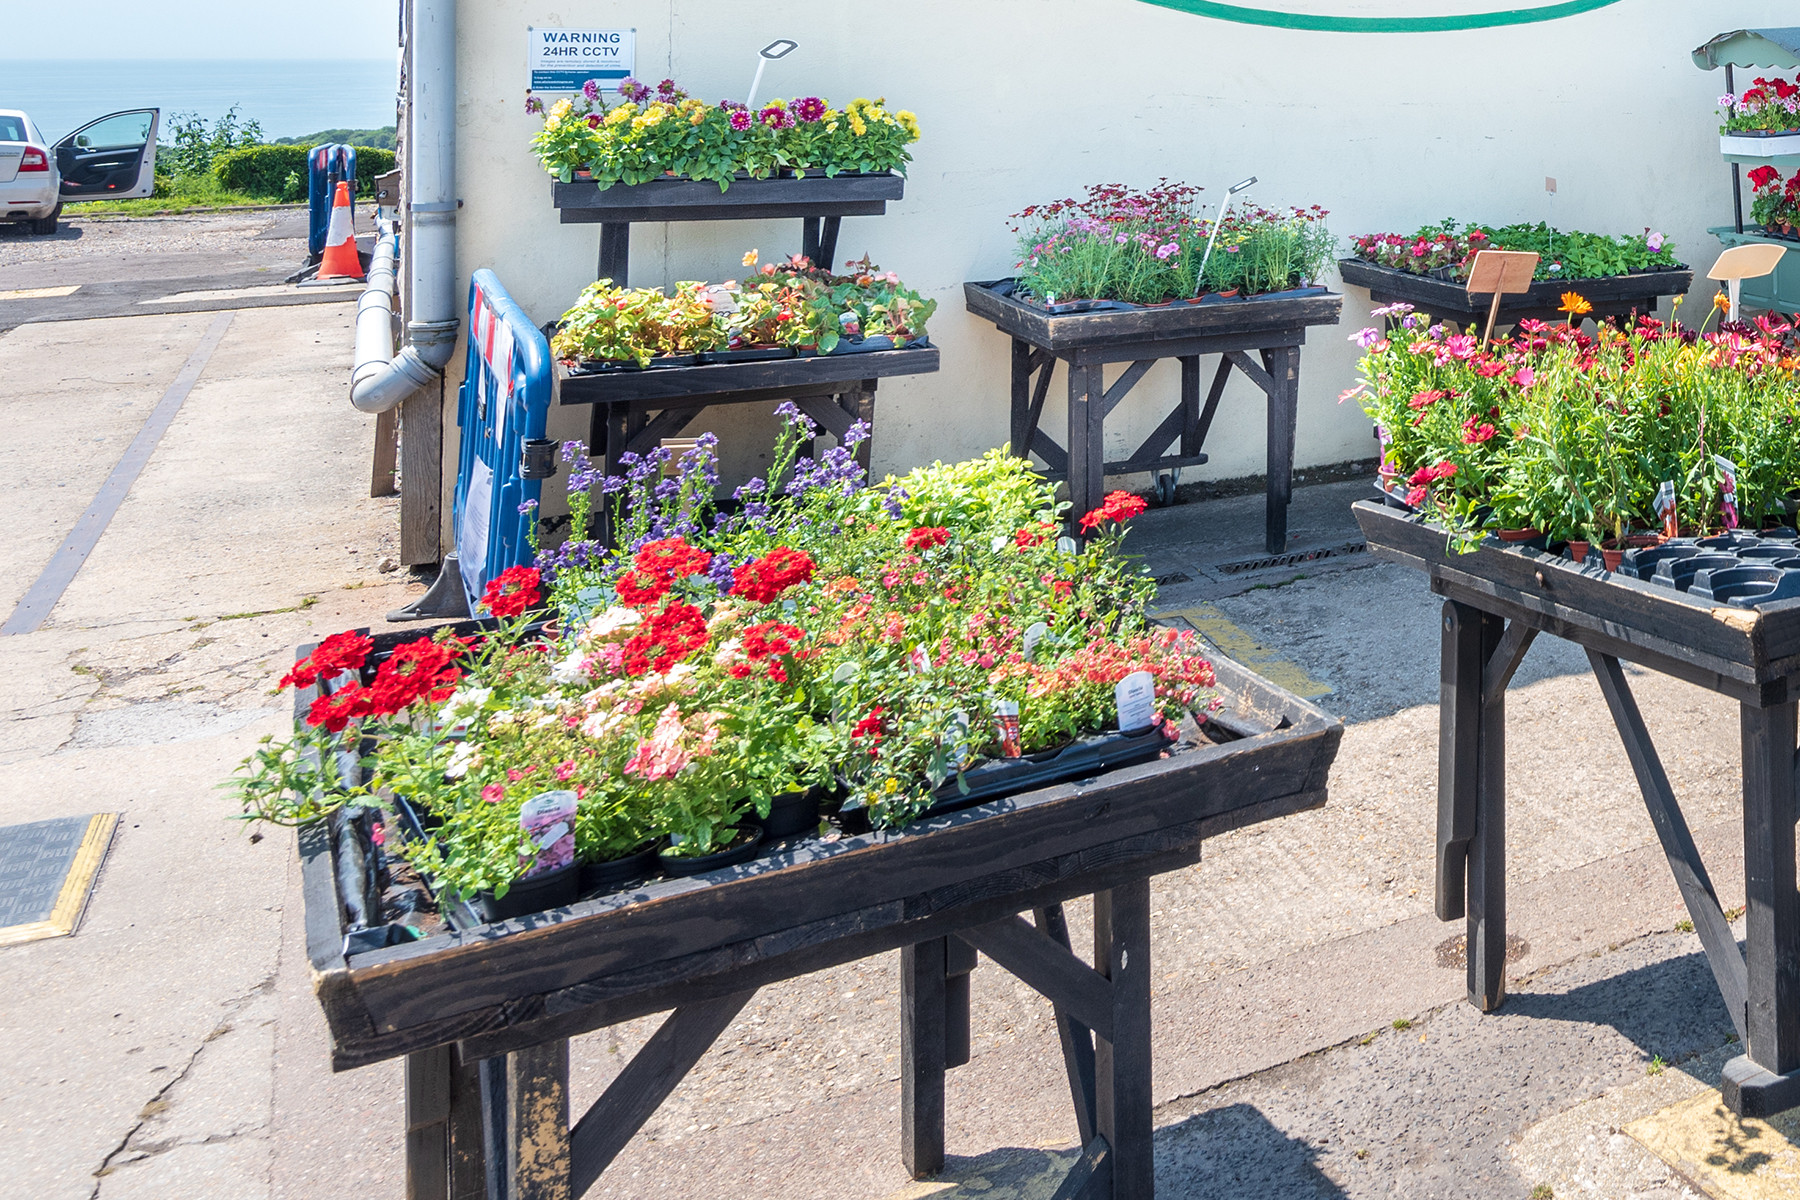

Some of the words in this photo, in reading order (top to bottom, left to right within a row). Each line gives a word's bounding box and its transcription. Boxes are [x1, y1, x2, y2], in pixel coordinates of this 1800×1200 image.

[543, 33, 621, 43] WARNING
[543, 47, 578, 56] 24HR
[582, 47, 619, 56] CCTV
